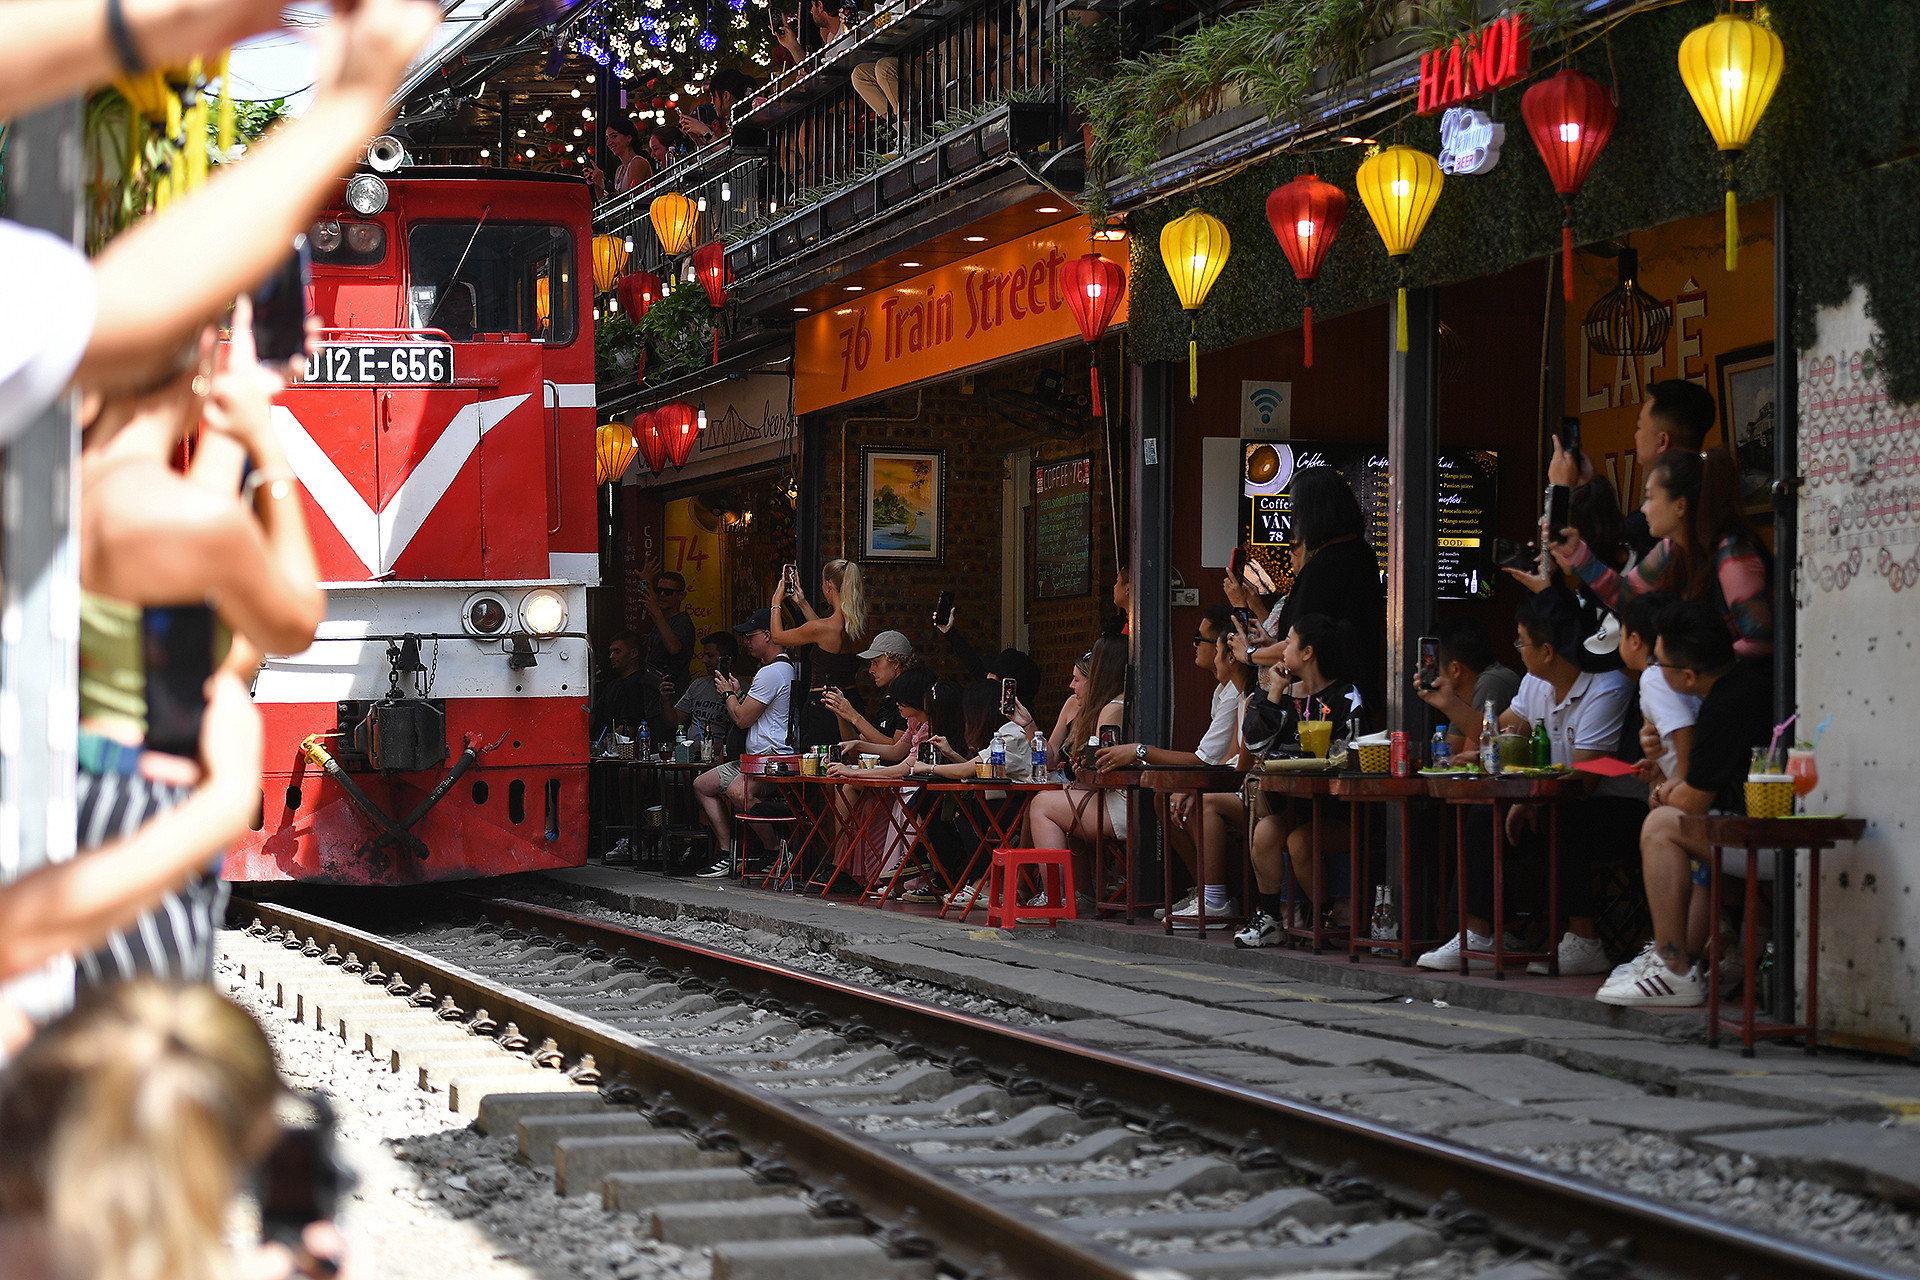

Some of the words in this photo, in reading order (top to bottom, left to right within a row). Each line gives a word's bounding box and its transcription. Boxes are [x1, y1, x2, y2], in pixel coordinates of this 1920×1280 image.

[1416, 13, 1525, 116] HANOI
[1456, 155, 1475, 170] BEER
[839, 306, 872, 392] 76
[881, 284, 954, 362] Train
[964, 246, 1066, 340] Street
[1262, 511, 1292, 530] VÂN
[1268, 531, 1284, 542] 78
[666, 535, 710, 572] 74
